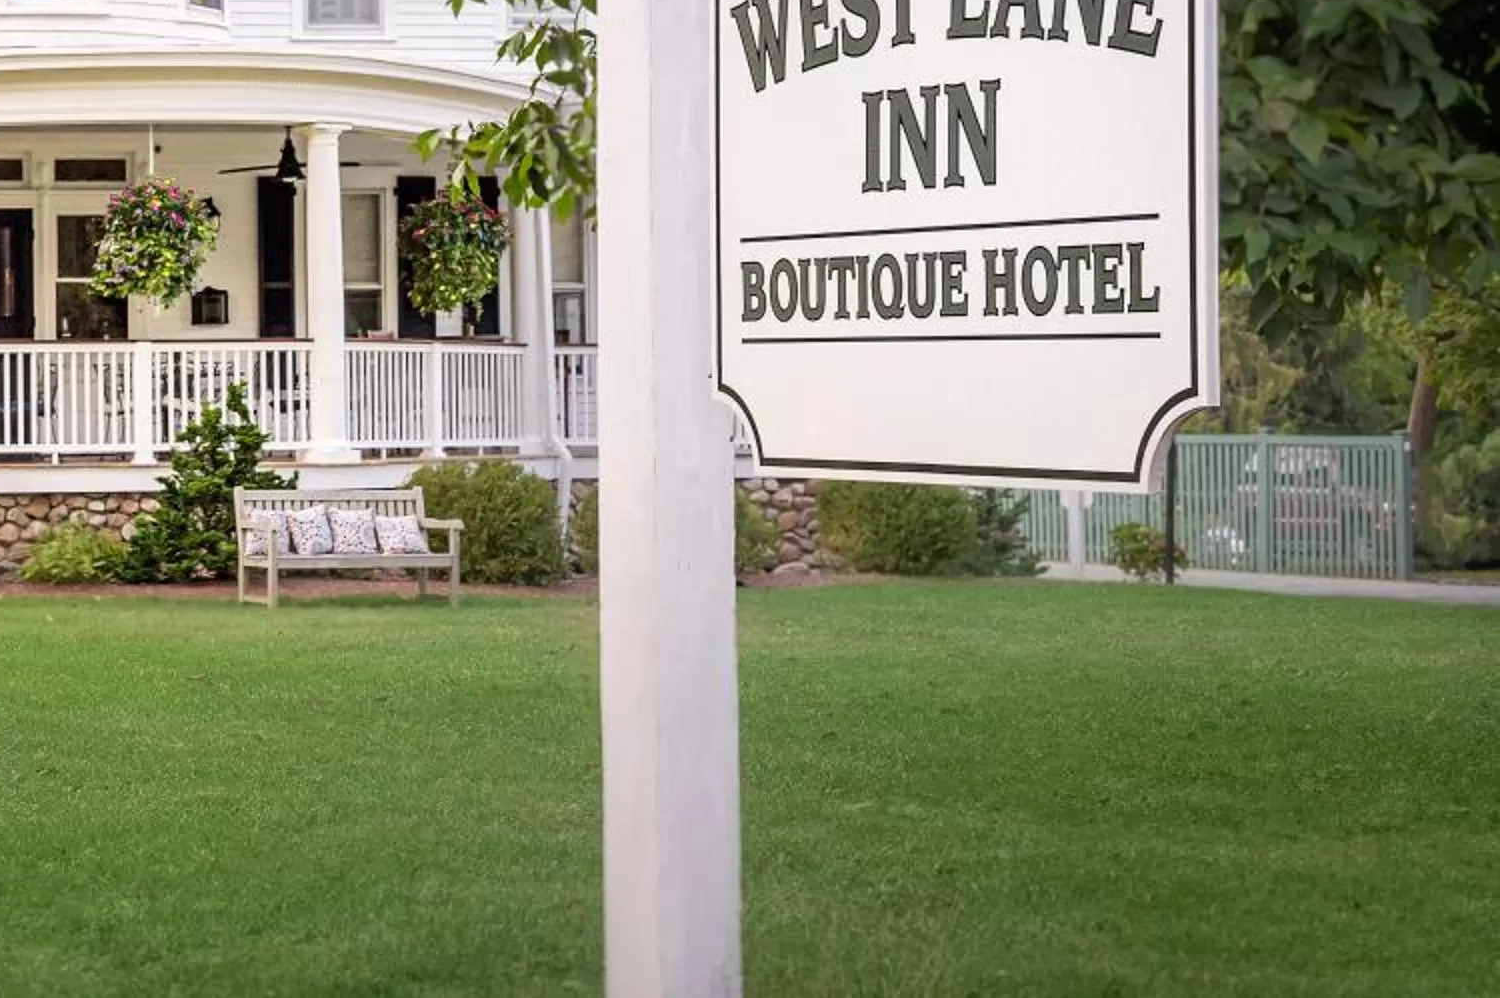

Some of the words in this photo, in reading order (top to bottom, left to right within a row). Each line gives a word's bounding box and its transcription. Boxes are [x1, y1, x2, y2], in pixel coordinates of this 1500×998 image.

[861, 77, 1001, 194] INN
[740, 250, 969, 323] BOUTIQUE
[982, 241, 1161, 317] HOTEL
